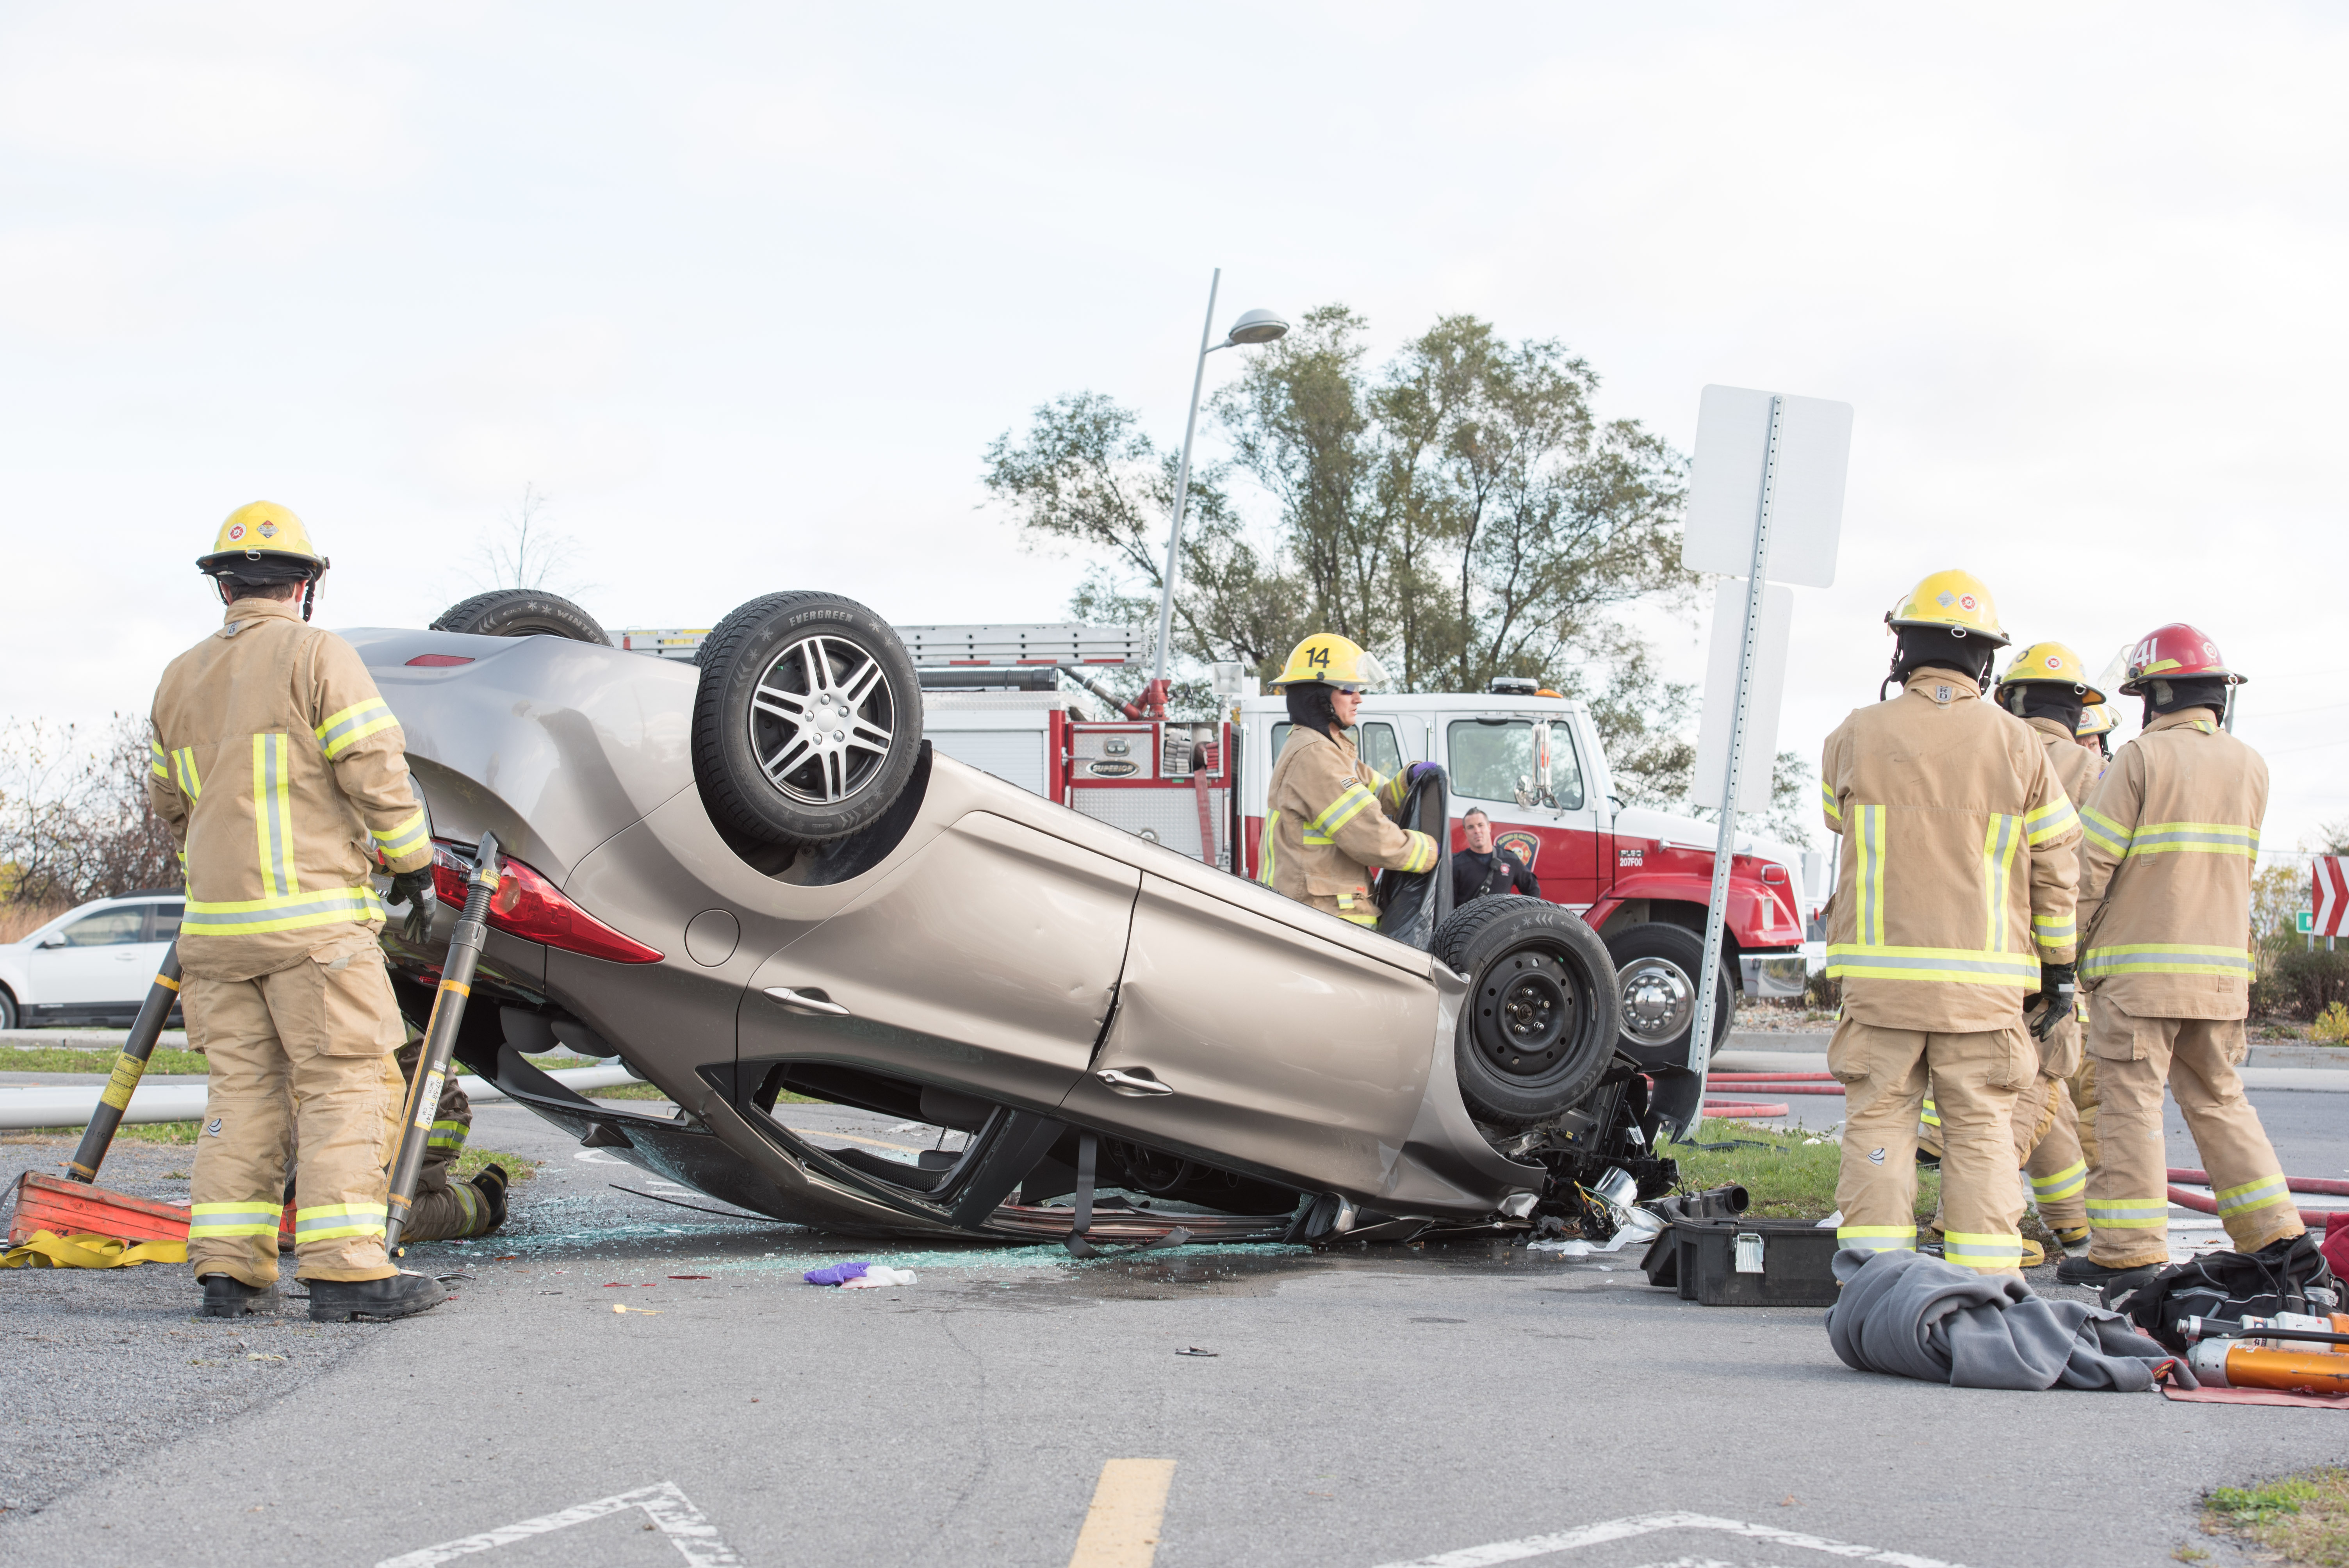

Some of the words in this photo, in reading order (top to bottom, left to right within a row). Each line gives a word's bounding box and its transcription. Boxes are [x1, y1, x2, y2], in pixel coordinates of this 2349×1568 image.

[788, 610, 853, 627] EVERGREEN
[1305, 647, 1330, 668] 14
[1619, 857, 1643, 867] 207F00
[432, 1080, 441, 1099] 37-58
[422, 1107, 428, 1115] CM
[425, 1102, 435, 1125] 91-147
